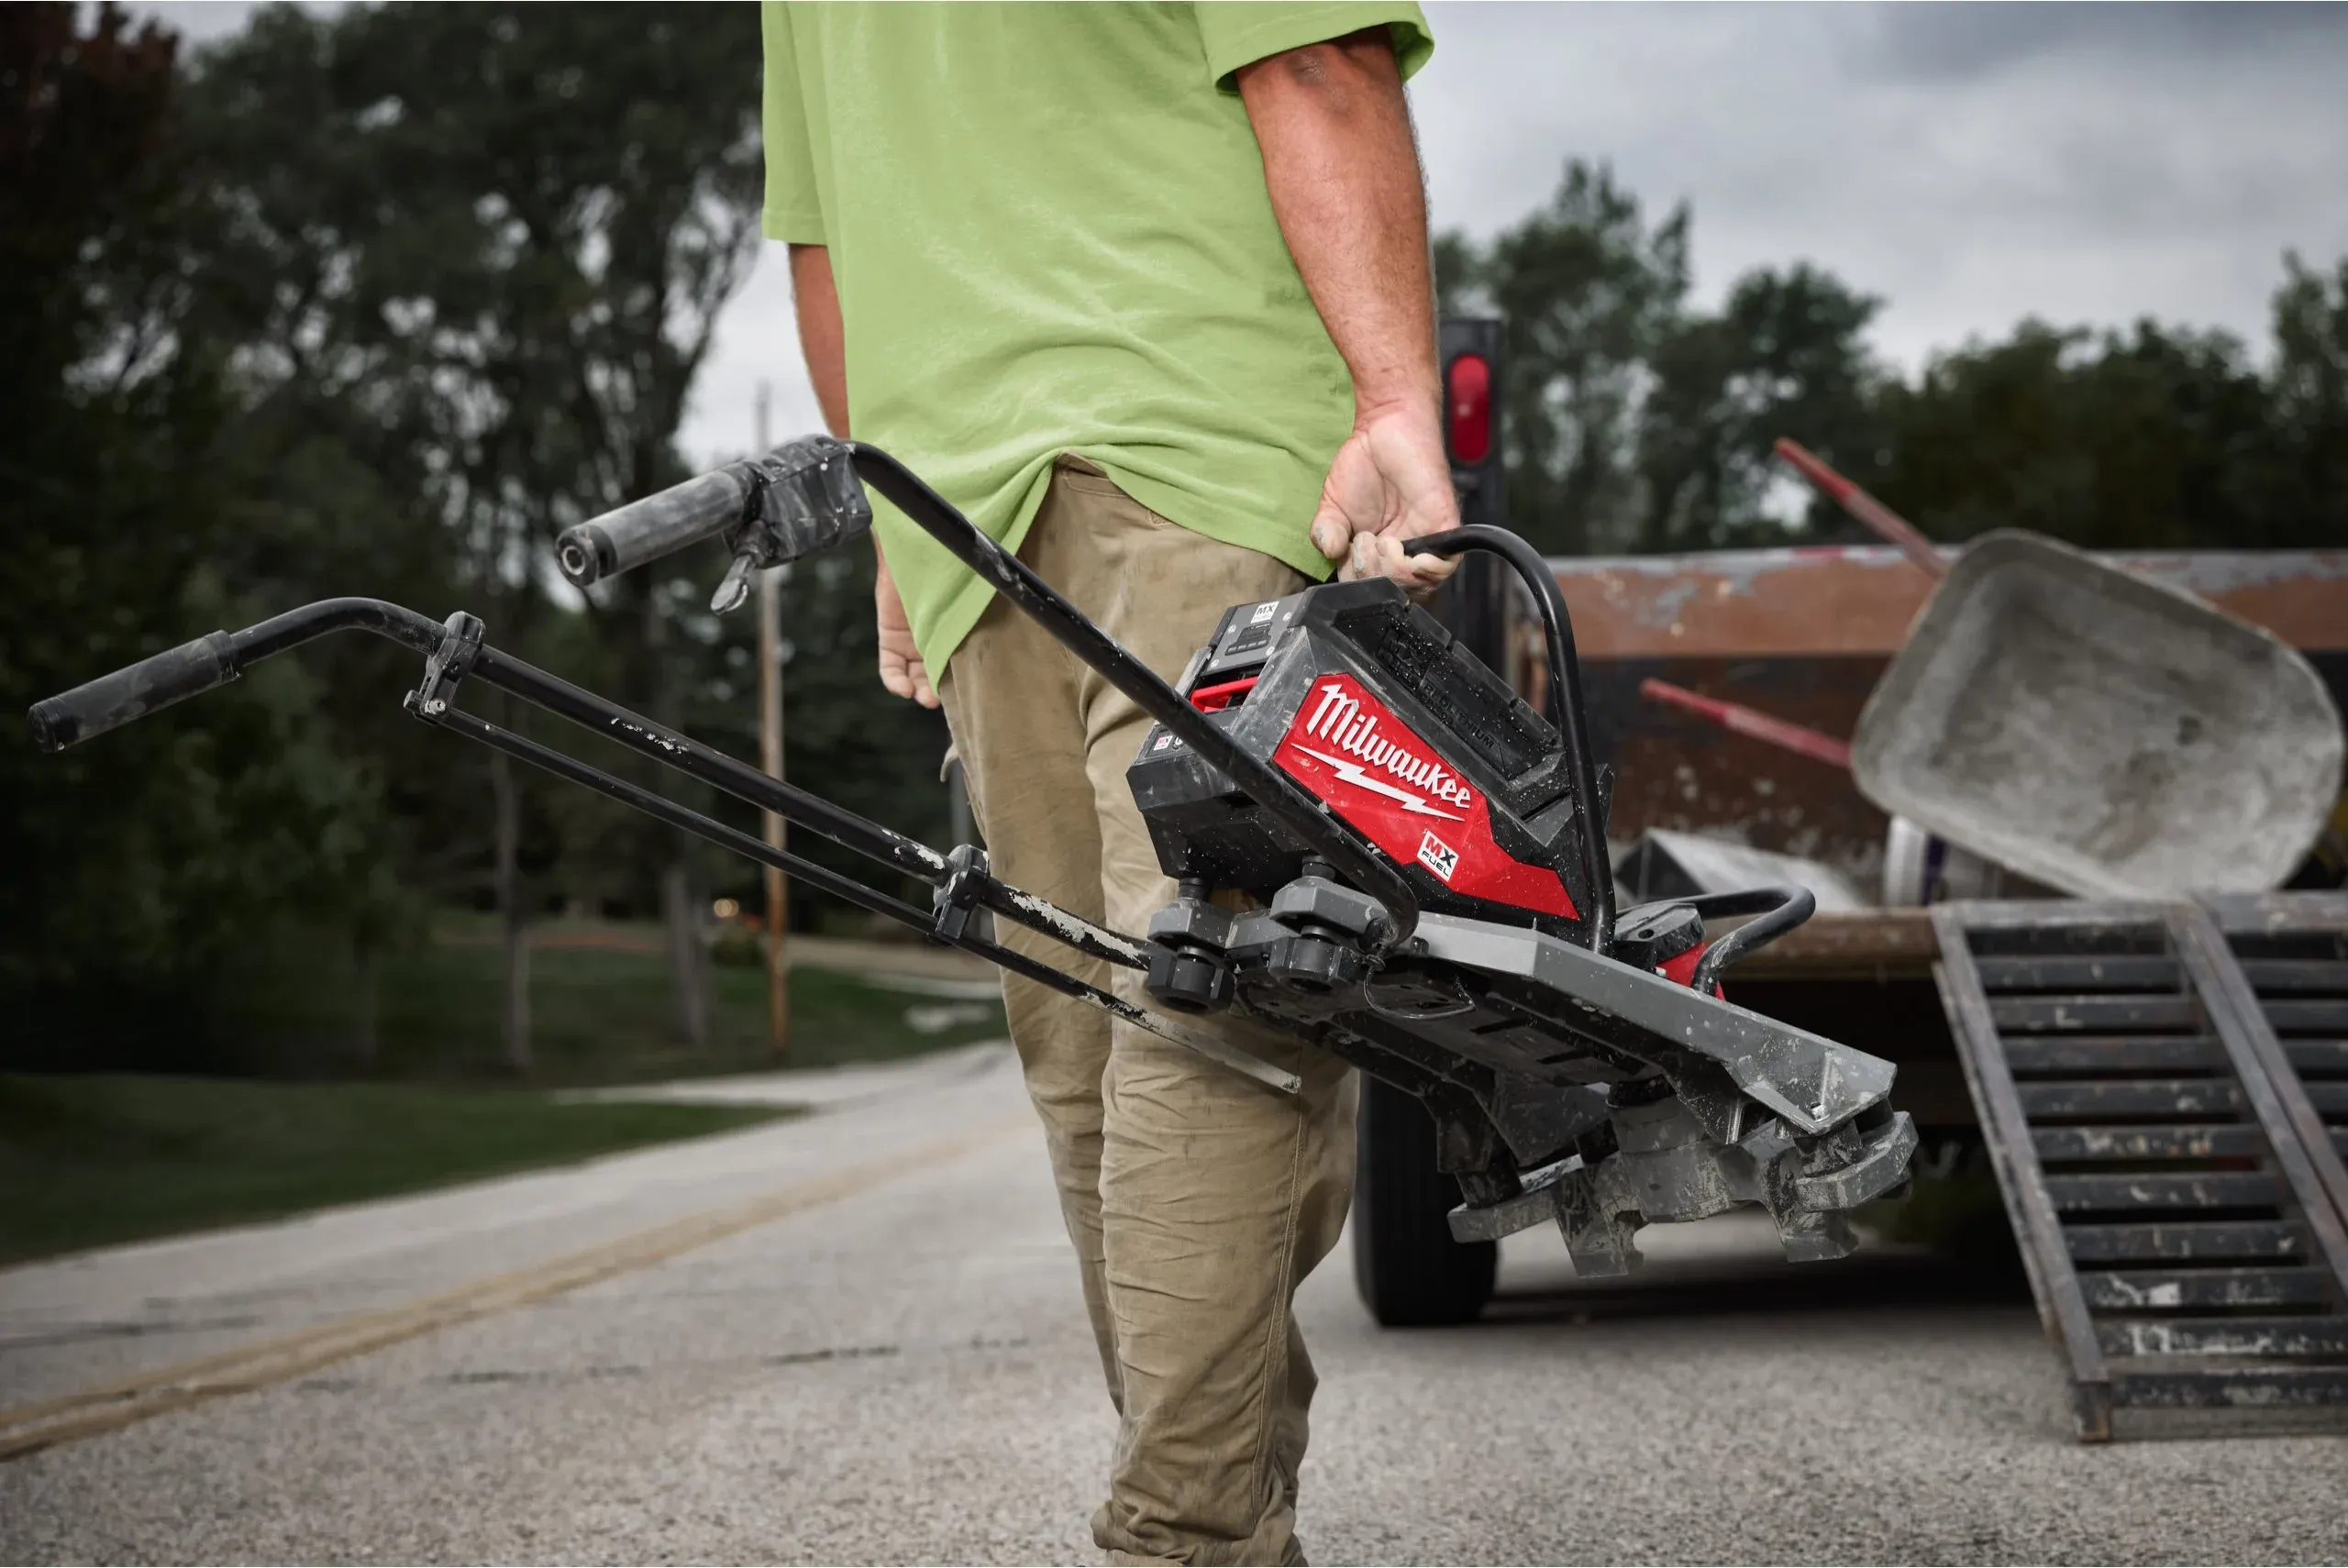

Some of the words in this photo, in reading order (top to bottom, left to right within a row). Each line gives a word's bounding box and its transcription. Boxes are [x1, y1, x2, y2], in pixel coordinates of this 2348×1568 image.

[1306, 684, 1471, 808] Milwaukee
[1422, 850, 1449, 878] FUEL
[1425, 835, 1456, 868] MX
